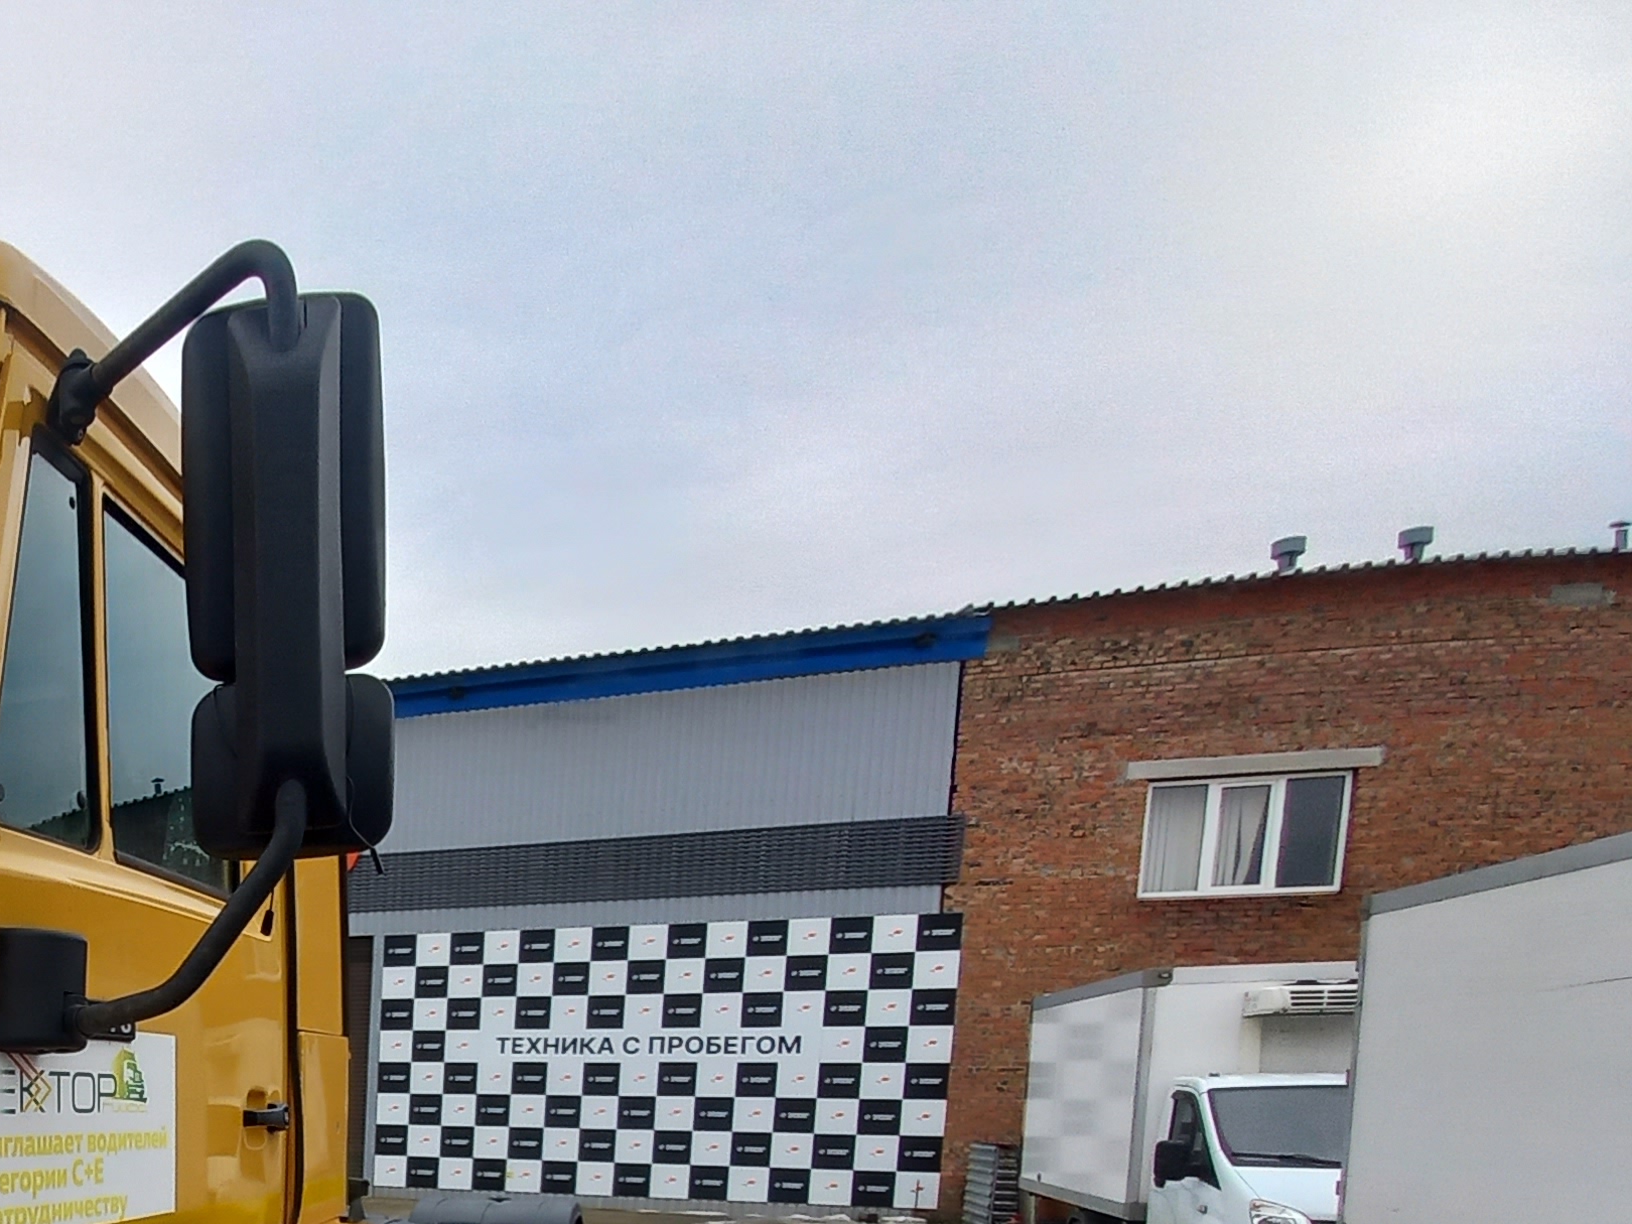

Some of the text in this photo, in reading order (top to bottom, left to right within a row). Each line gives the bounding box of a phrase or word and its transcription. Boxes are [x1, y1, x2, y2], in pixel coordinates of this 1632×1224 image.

[496, 1035, 802, 1055] ТЕХНИКА С ПРОБЕГОМ
[87, 1125, 167, 1156] водителей
